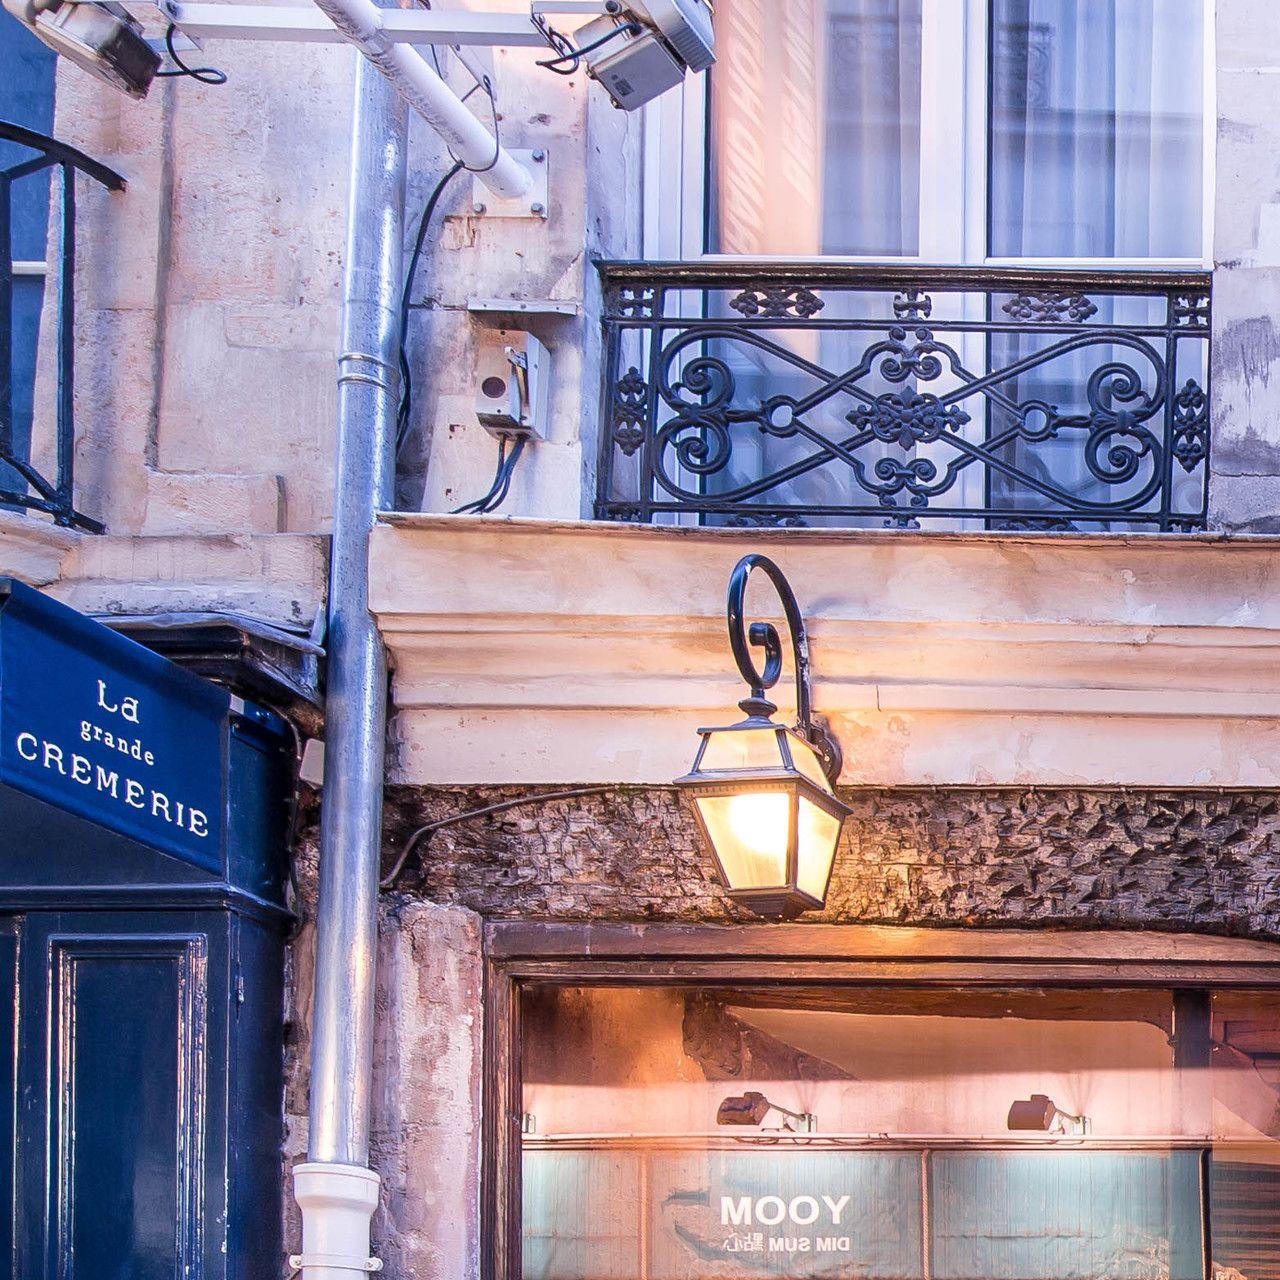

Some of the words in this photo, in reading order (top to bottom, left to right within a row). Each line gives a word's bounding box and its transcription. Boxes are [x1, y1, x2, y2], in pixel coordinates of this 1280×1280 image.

[98, 680, 139, 723] La
[81, 720, 154, 765] grande
[17, 732, 208, 836] CREMERIE
